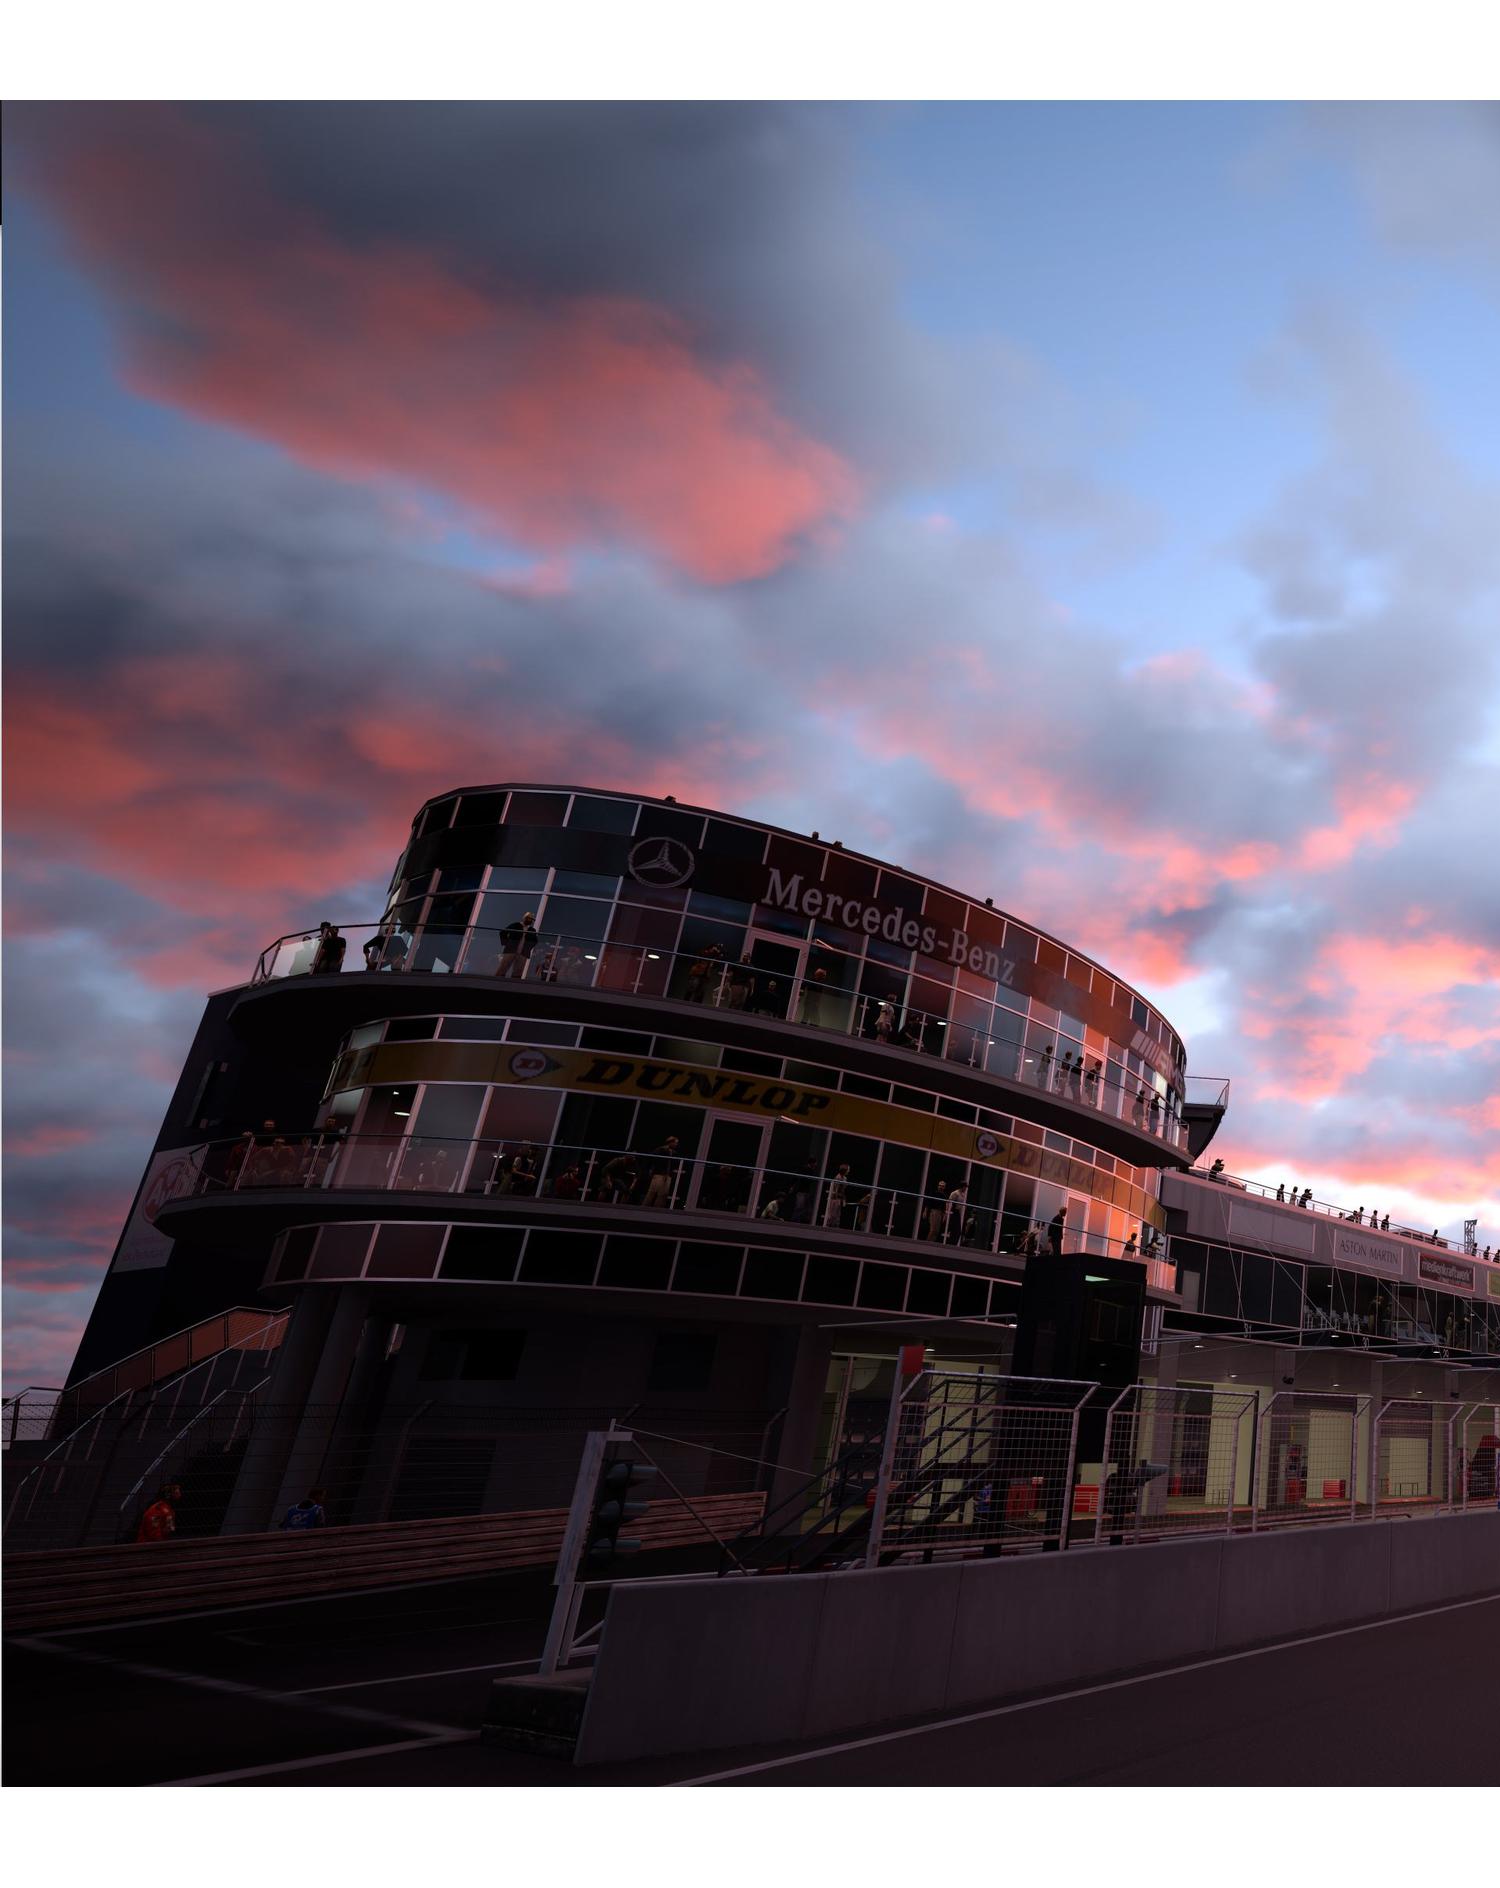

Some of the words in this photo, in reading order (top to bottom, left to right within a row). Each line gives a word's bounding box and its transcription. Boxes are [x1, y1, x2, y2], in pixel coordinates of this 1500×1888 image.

[761, 867, 1017, 986] Mercedes-Benz
[576, 1059, 831, 1116] DUNLOP
[1340, 1238, 1367, 1258] ASTON
[1369, 1247, 1399, 1265] MARTIN
